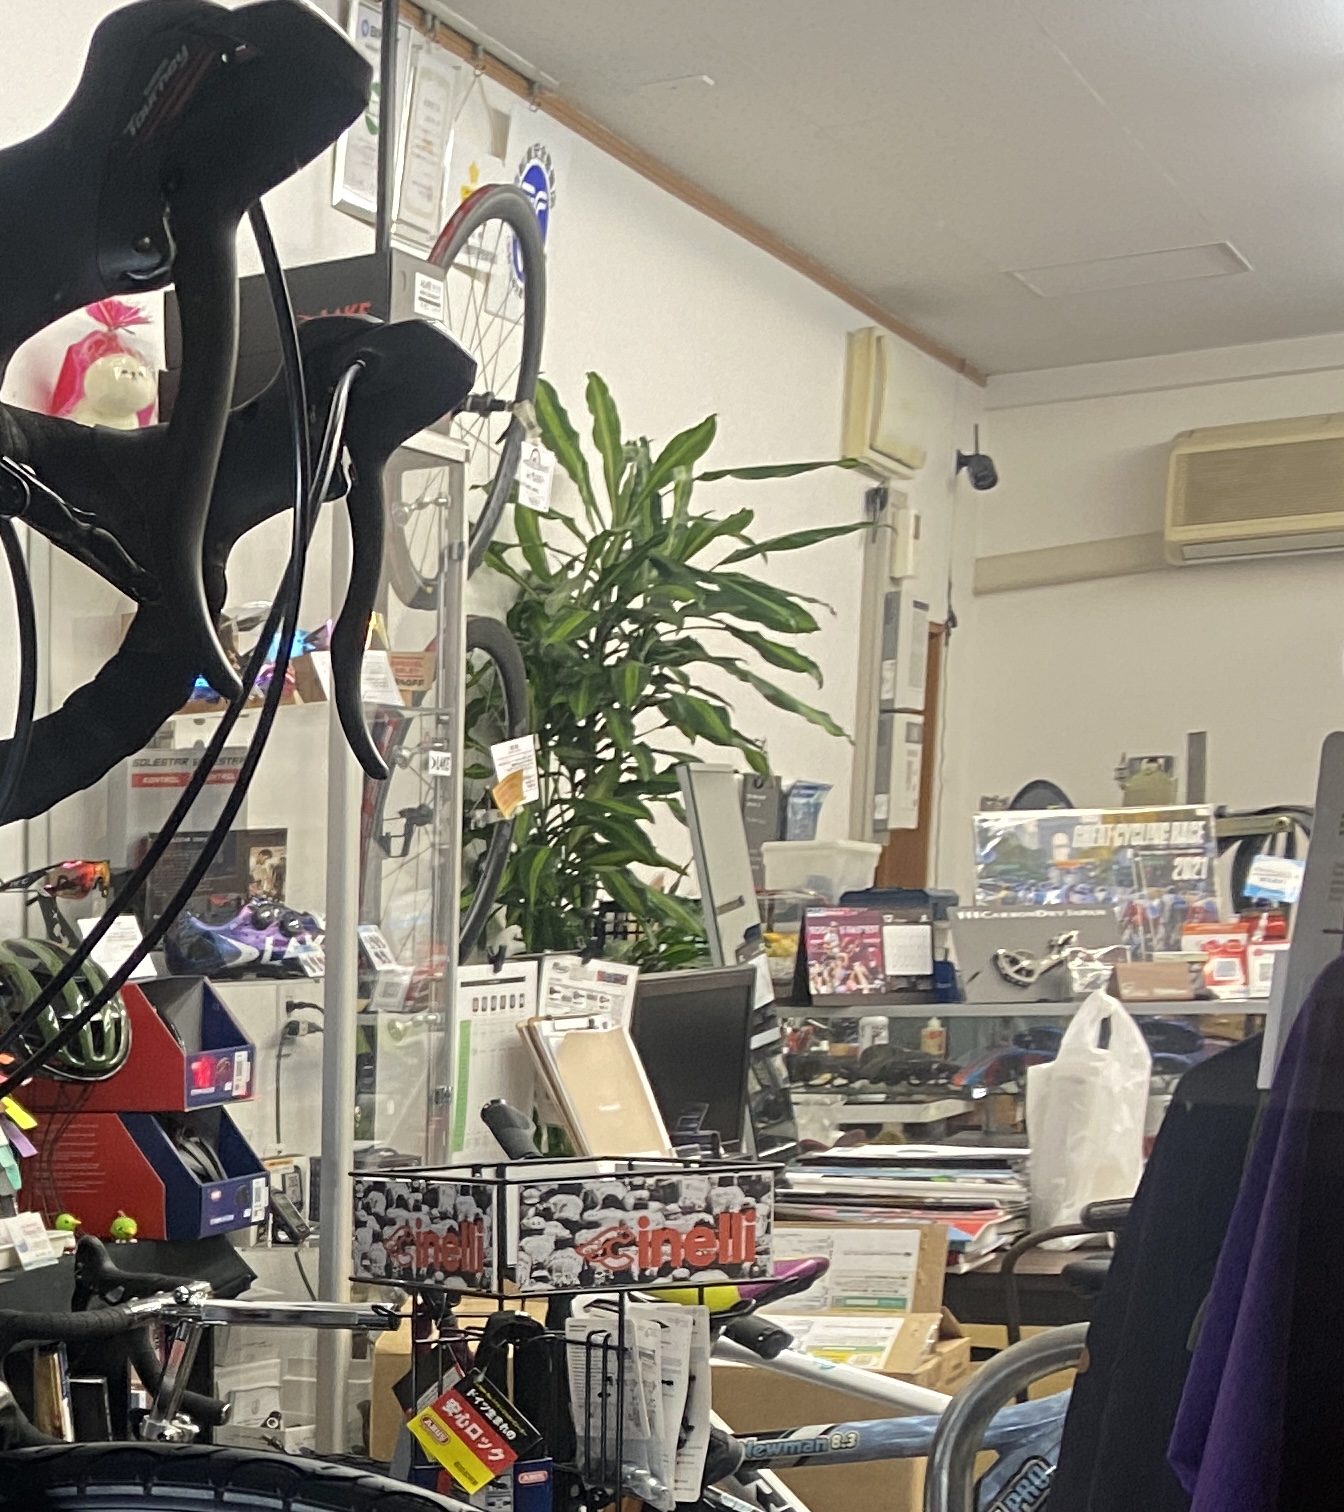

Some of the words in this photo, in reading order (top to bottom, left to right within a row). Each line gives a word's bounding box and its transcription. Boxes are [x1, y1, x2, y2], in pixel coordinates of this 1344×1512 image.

[442, 1398, 506, 1462] 安心ロック
[829, 1430, 858, 1451] 8.3
